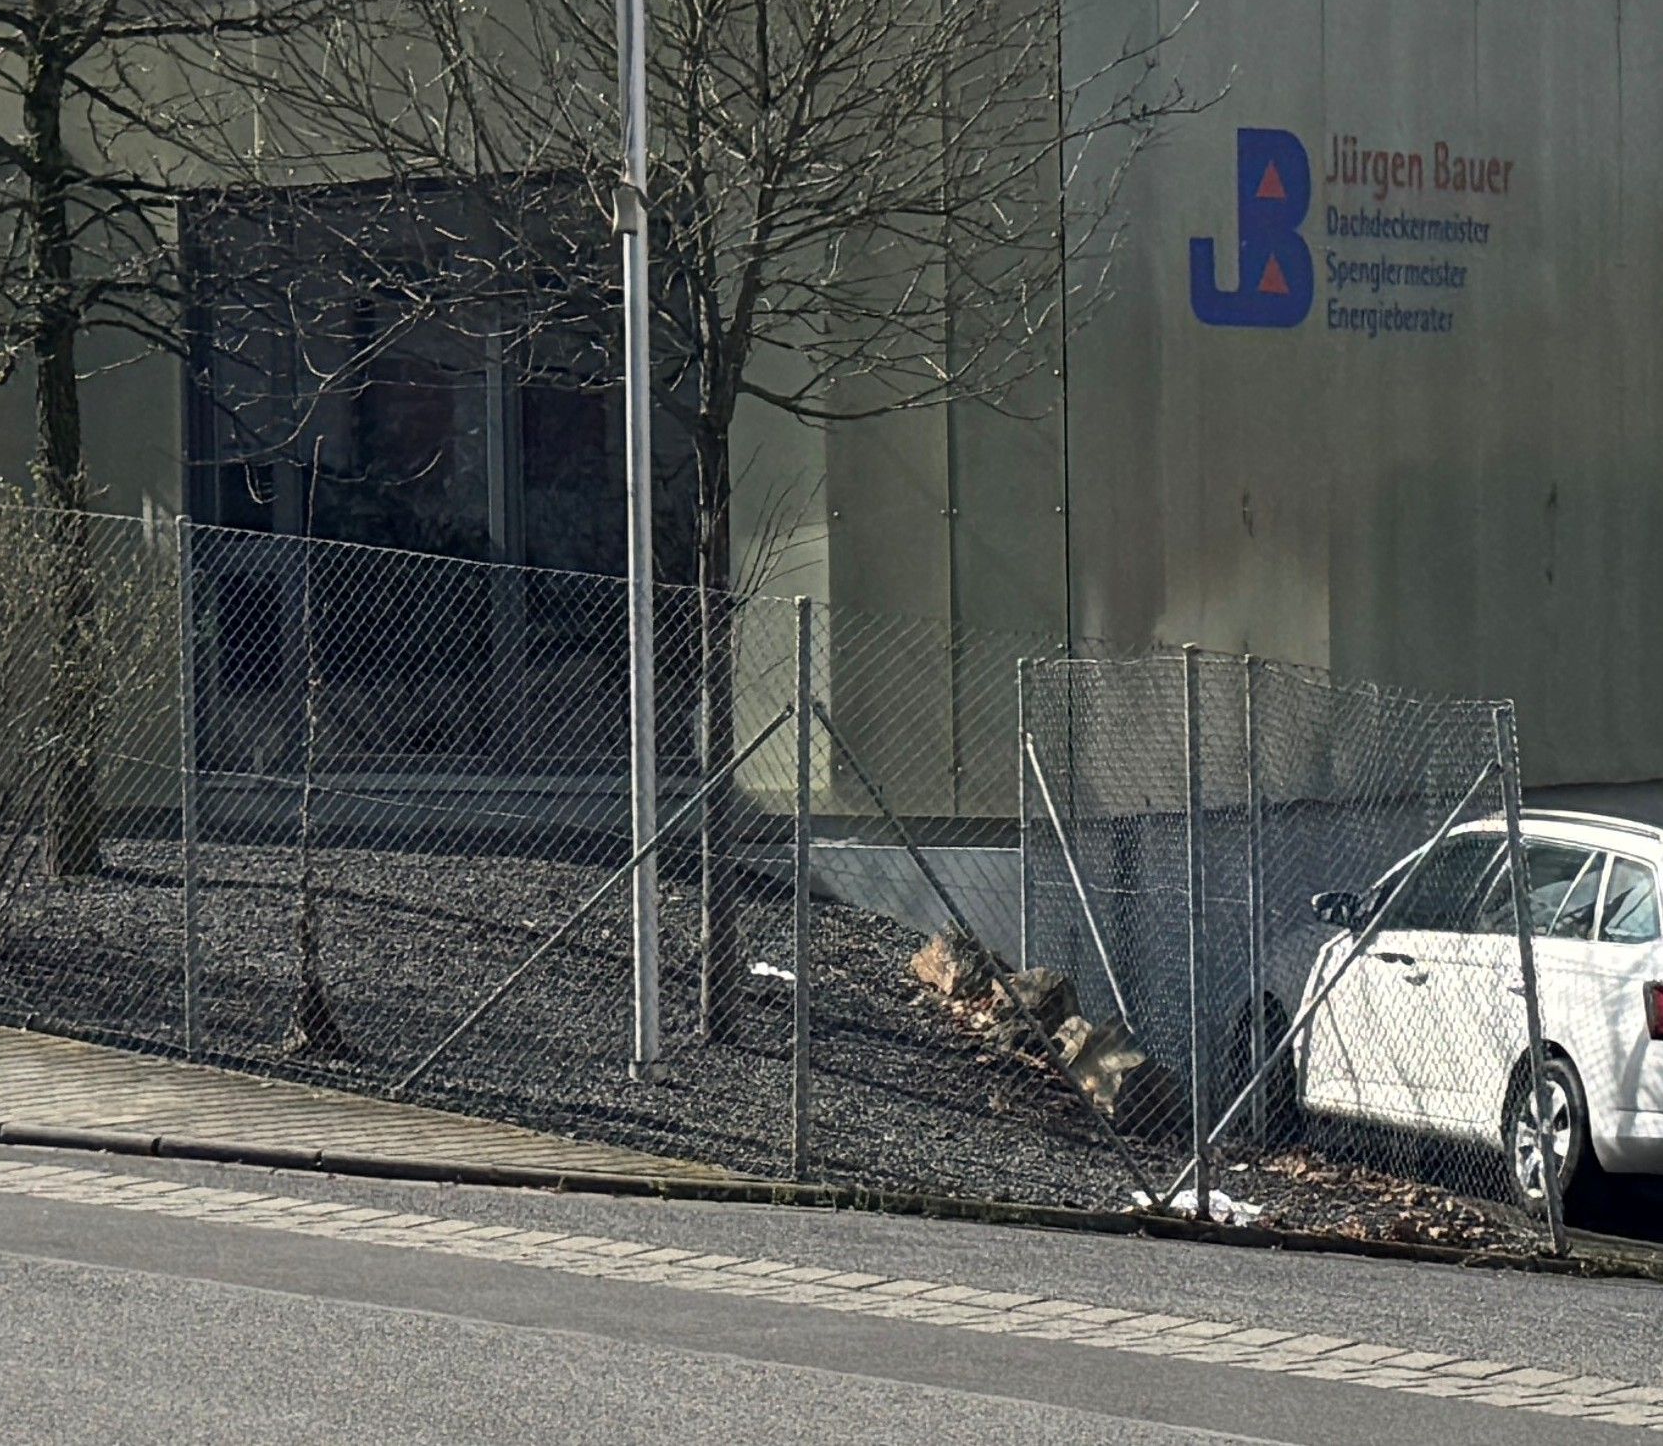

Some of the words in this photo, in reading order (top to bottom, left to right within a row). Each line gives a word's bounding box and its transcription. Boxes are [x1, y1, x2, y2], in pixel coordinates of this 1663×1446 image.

[1325, 134, 1424, 201] Jürgen
[1433, 140, 1514, 195] Bauer
[1327, 205, 1490, 245] Dachdeckermeister
[1326, 250, 1468, 293] Spenglermeister
[1327, 297, 1454, 339] Energieberater
